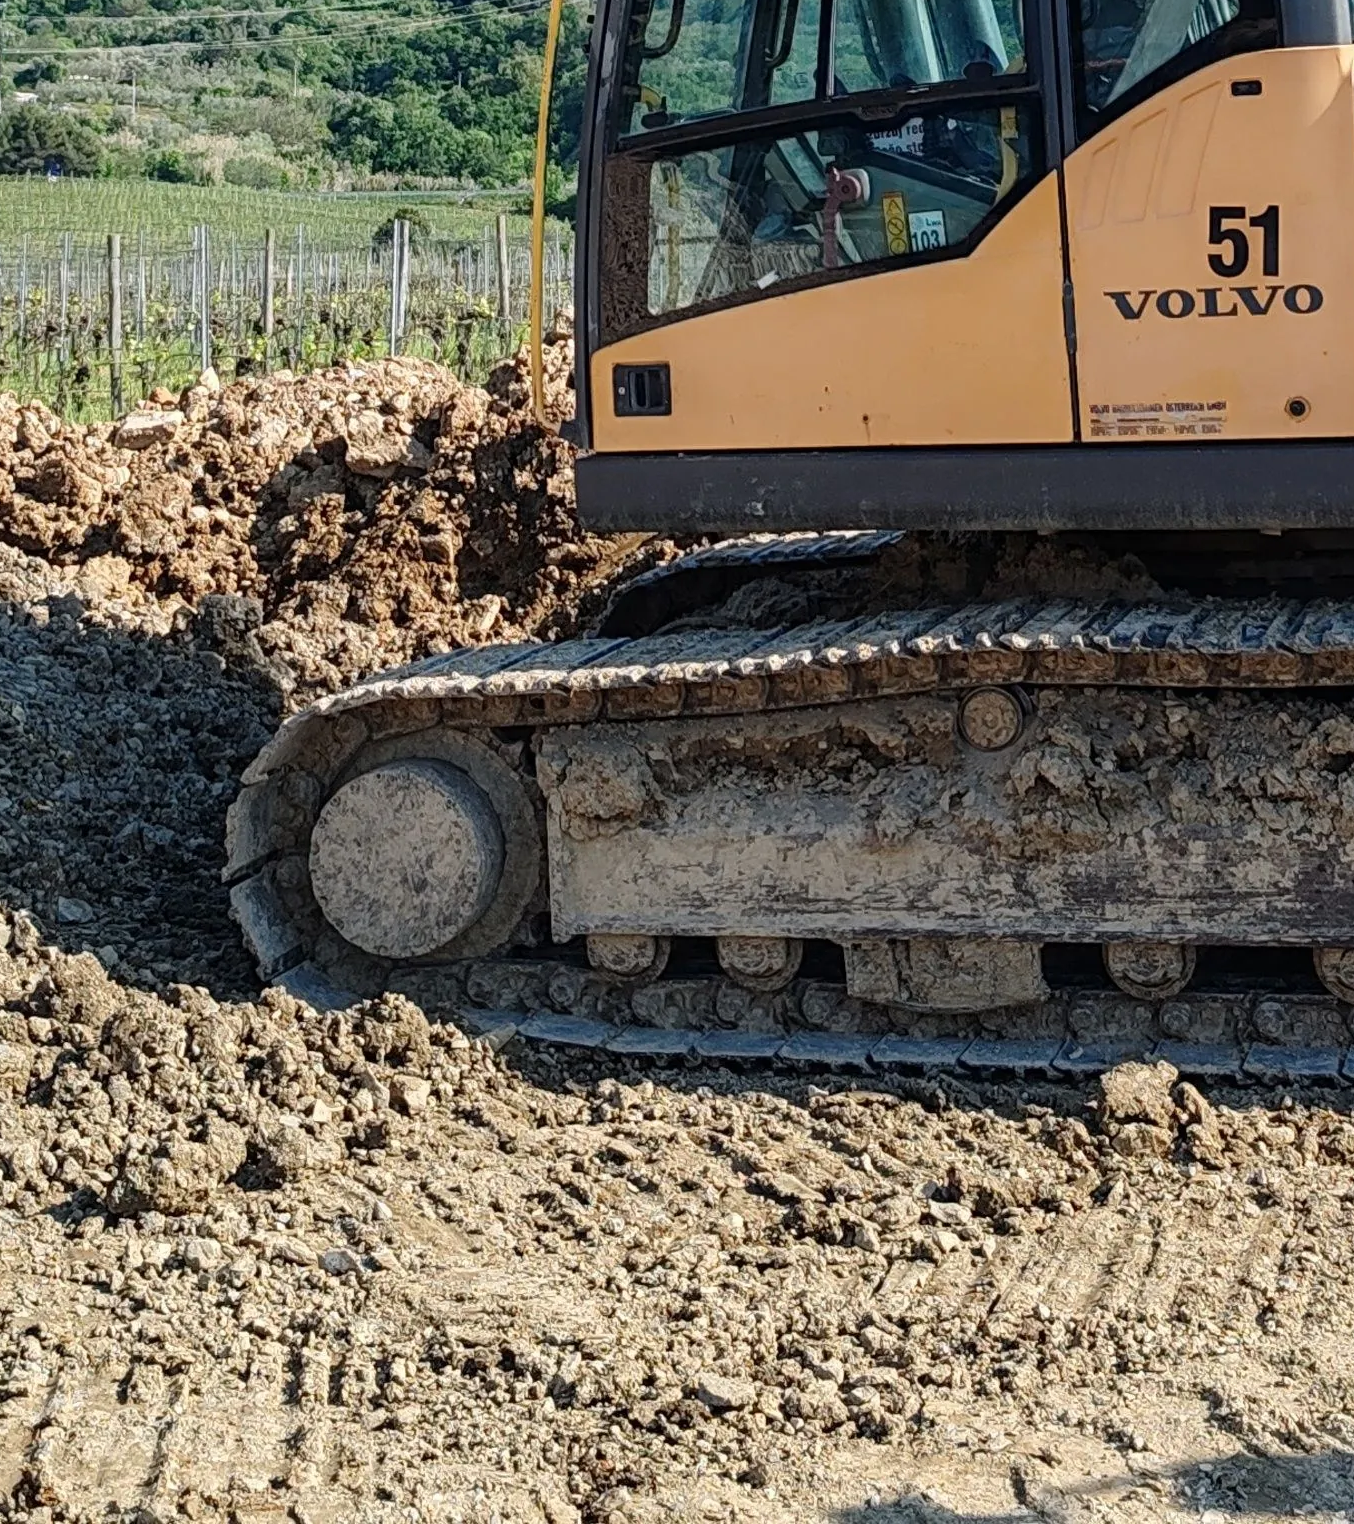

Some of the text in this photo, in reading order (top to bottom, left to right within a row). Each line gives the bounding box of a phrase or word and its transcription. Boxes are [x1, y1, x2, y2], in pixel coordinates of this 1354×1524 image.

[911, 229, 941, 251] 103
[1207, 204, 1280, 277] 51
[1103, 284, 1324, 321] VOLVO
